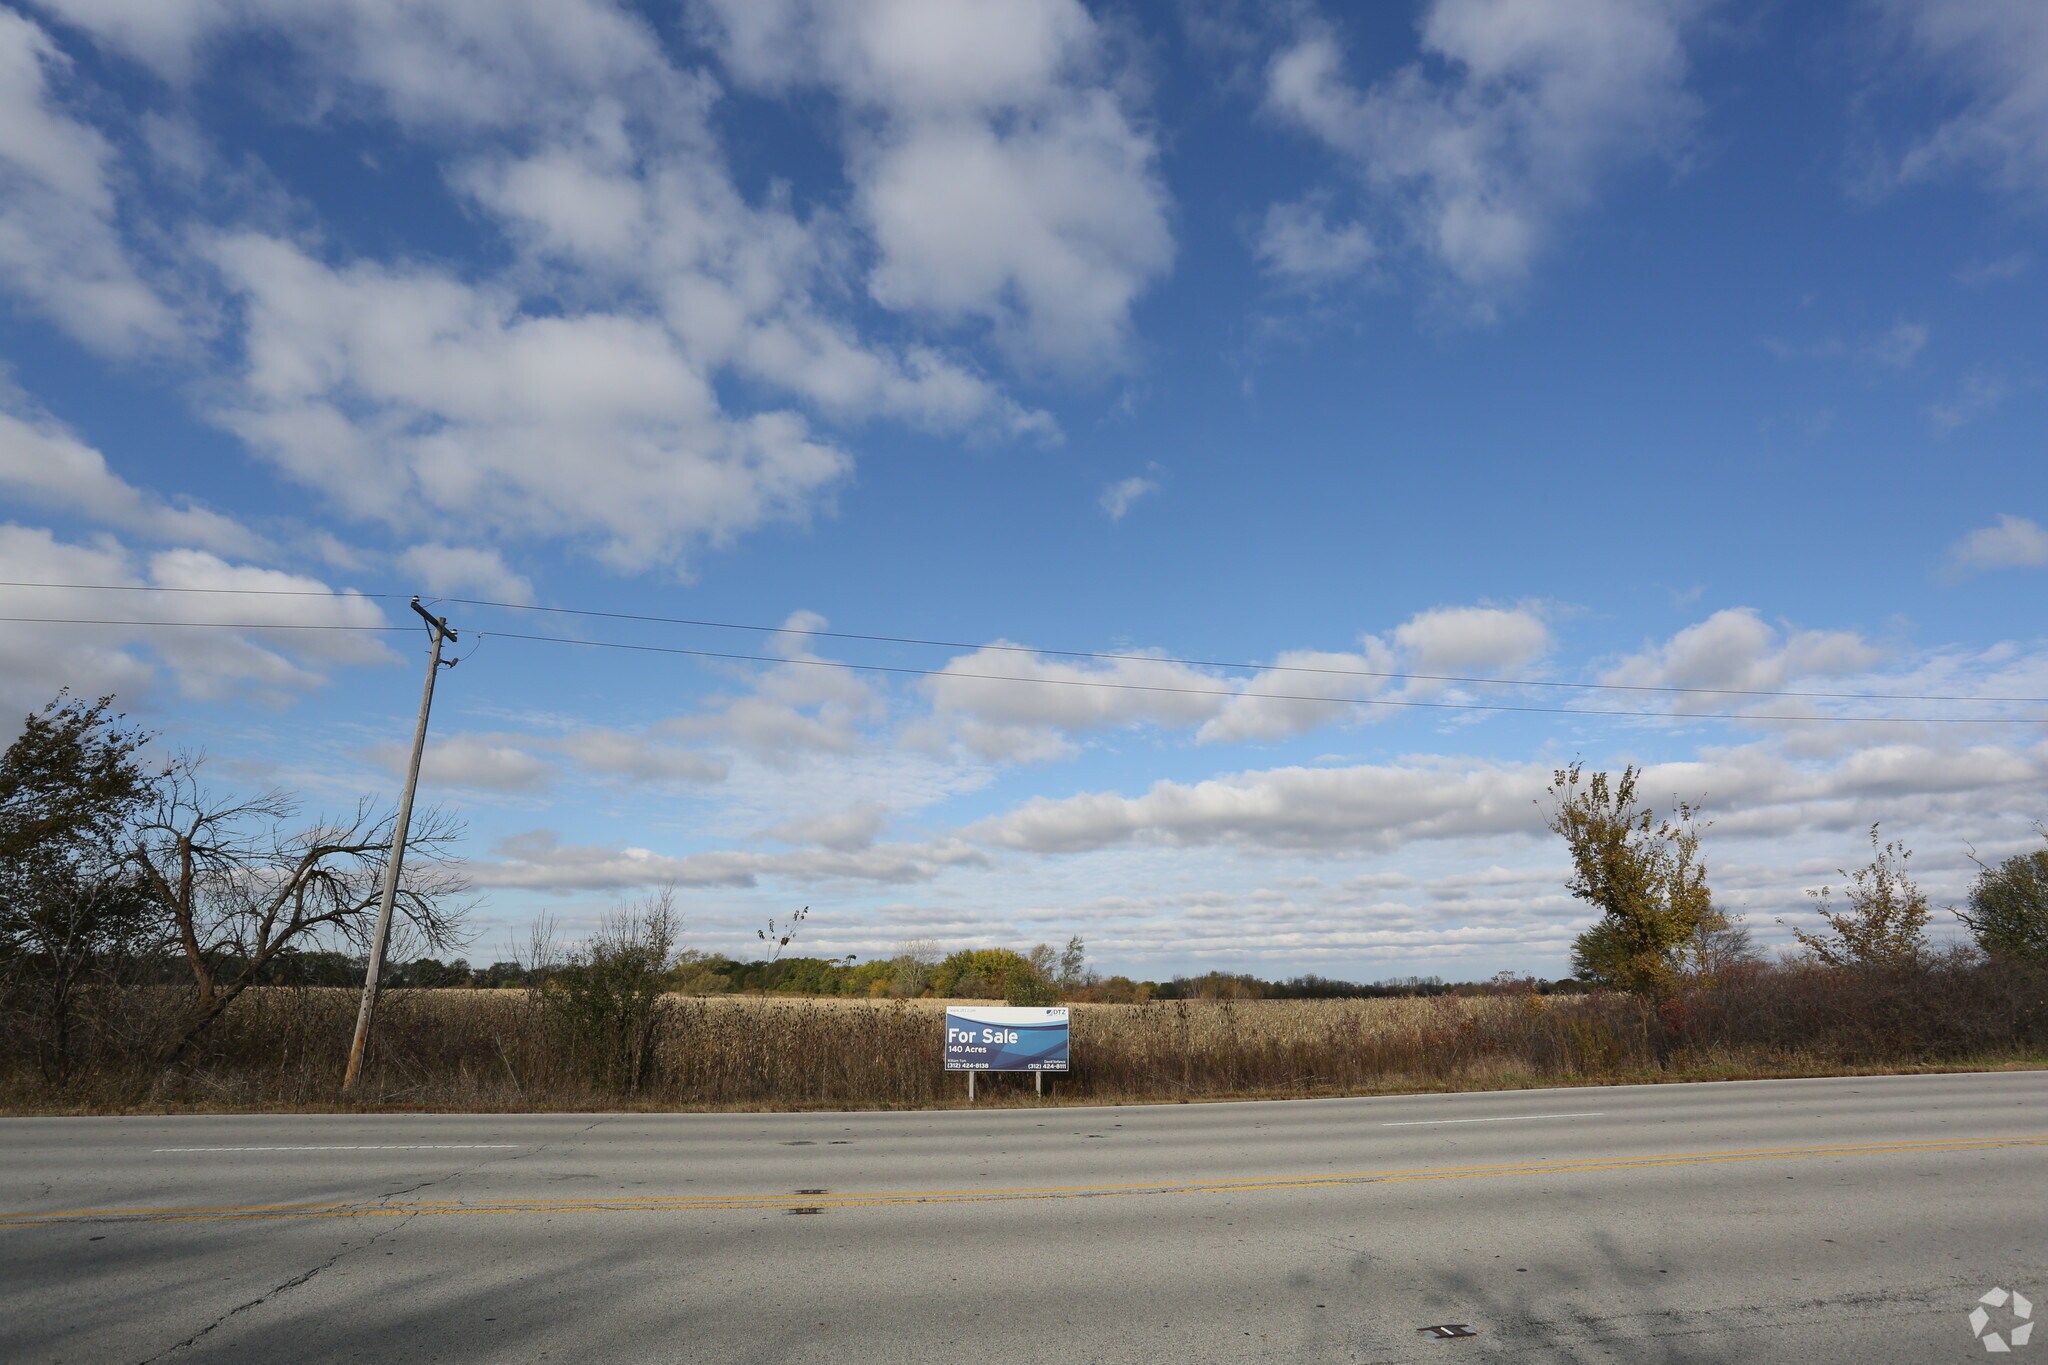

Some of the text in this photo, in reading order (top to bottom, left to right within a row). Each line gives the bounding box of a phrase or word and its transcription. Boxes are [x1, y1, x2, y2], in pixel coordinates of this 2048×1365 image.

[948, 1028, 1018, 1044] For Sale
[948, 1045, 987, 1053] 140 Acres
